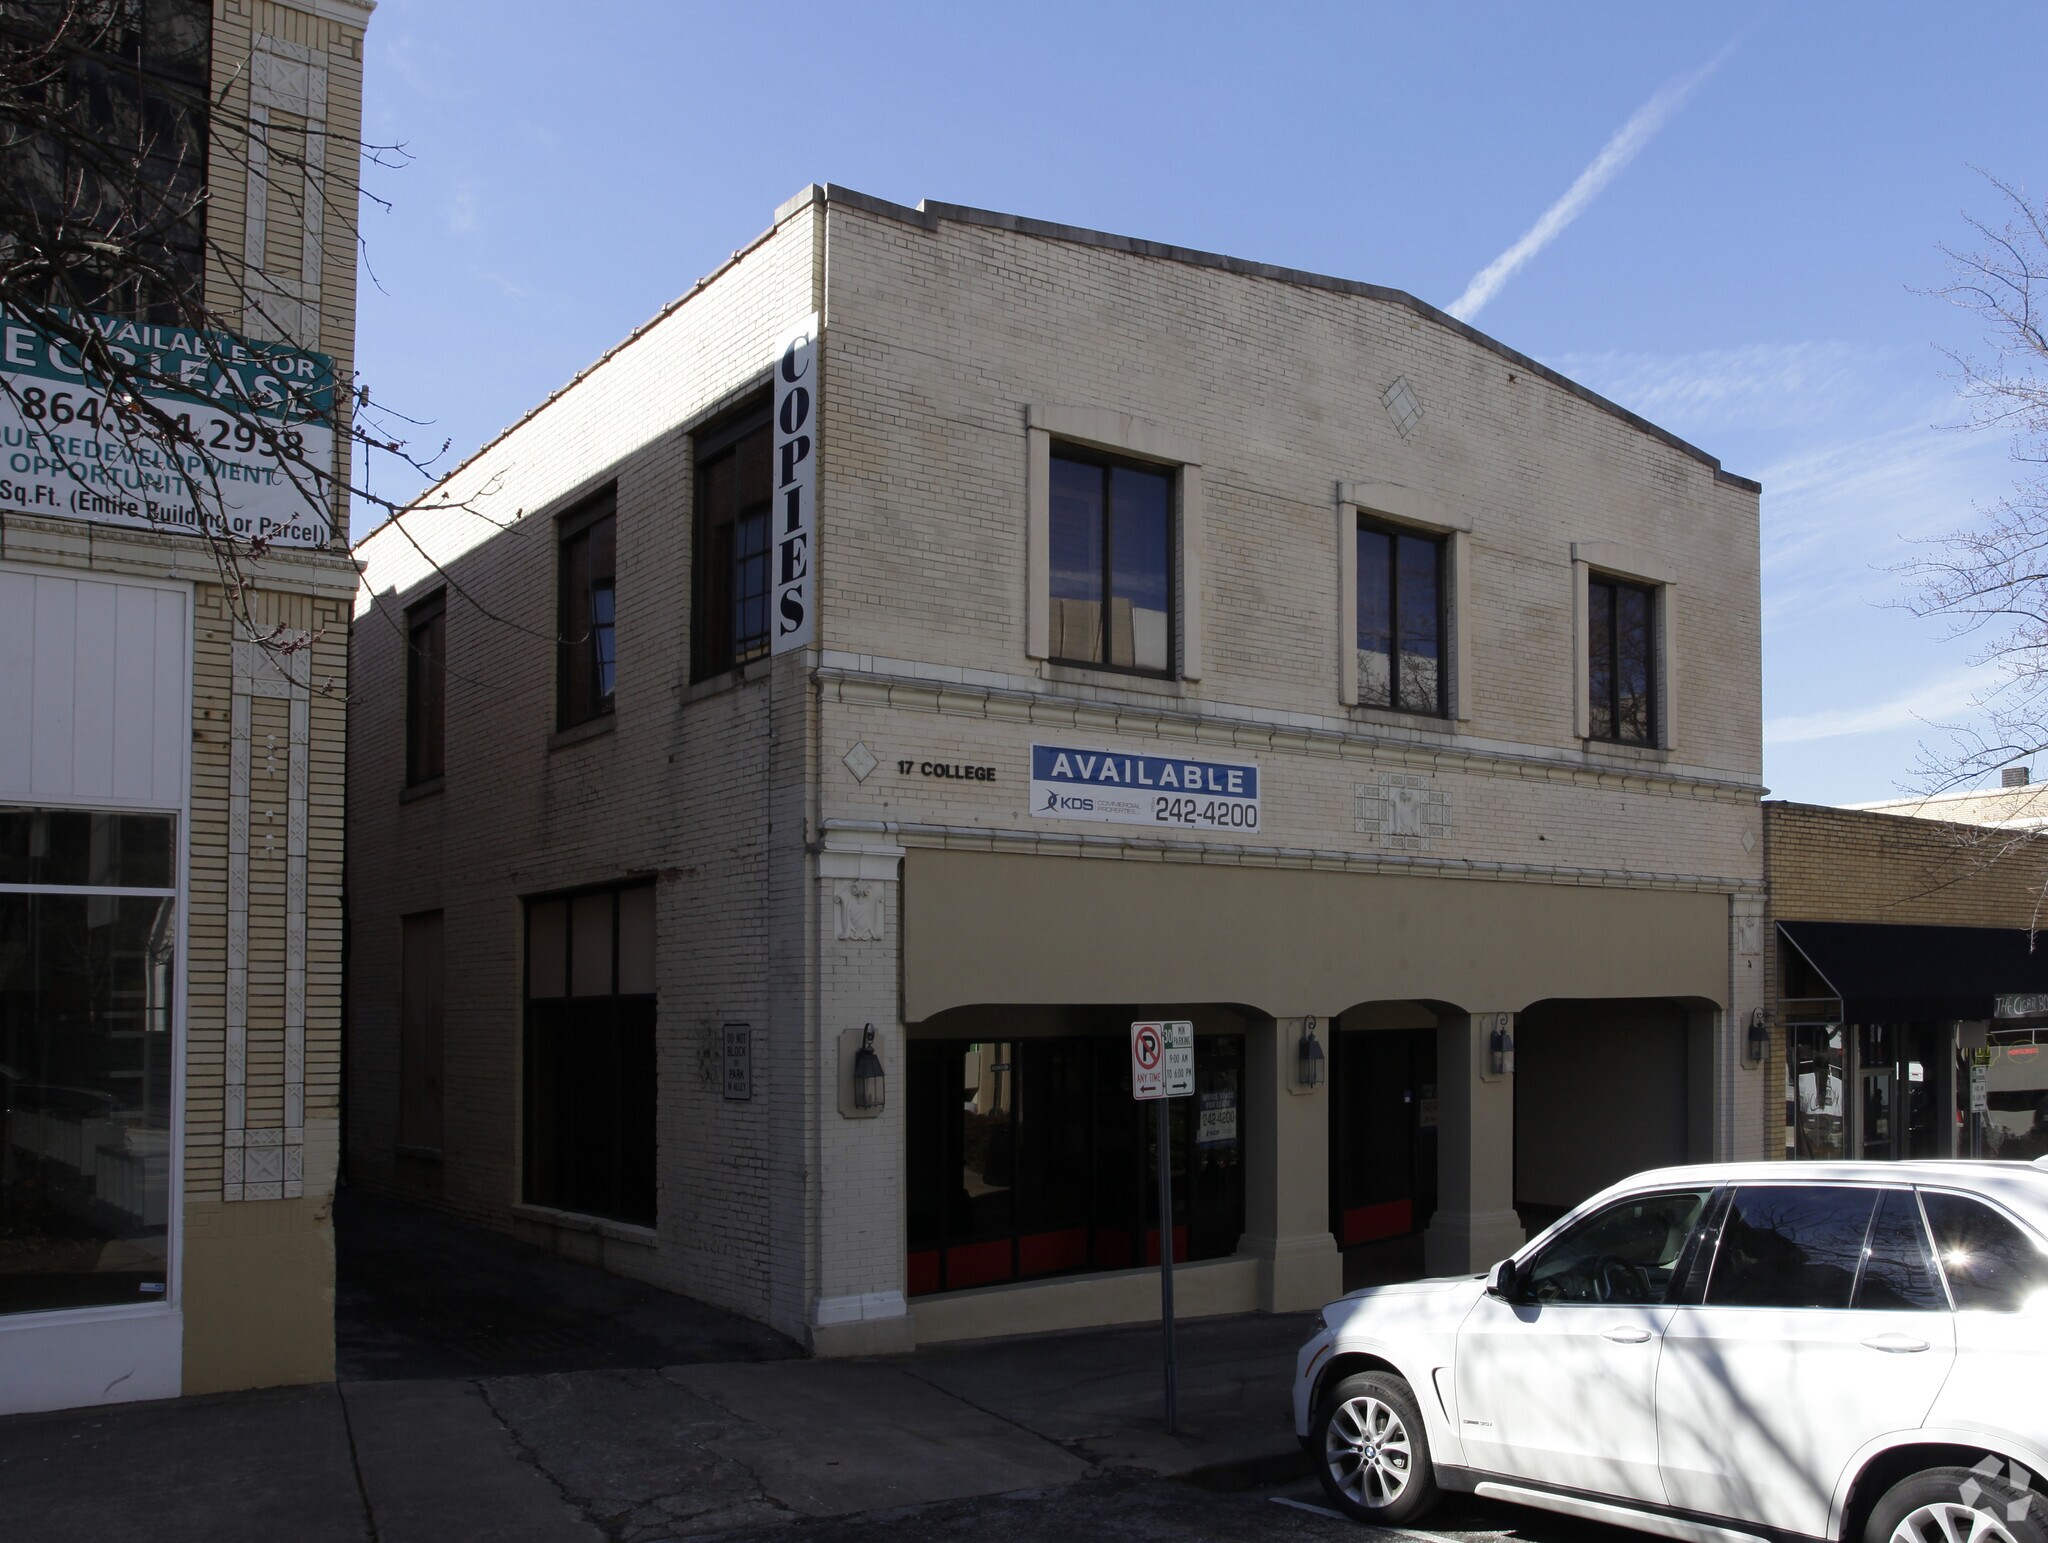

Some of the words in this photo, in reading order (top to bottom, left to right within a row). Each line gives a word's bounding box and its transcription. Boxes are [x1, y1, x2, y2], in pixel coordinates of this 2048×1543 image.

[150, 353, 314, 414] LEASE
[22, 387, 304, 462] 864.54.2938
[0, 426, 40, 449] UE
[50, 434, 274, 485] REDEVELOPMENT
[778, 335, 811, 637] COPIES
[71, 490, 138, 517] (Entire
[233, 517, 253, 533] or
[259, 516, 326, 545] Parcel)
[897, 760, 914, 775] 17
[921, 761, 996, 782] COLLEGE
[1051, 753, 1244, 793] AVAILABLE
[1061, 797, 1094, 811] KDS
[1156, 797, 1258, 828] 242-4200
[1137, 1073, 1147, 1083] ANY
[1149, 1073, 1161, 1082] TIME
